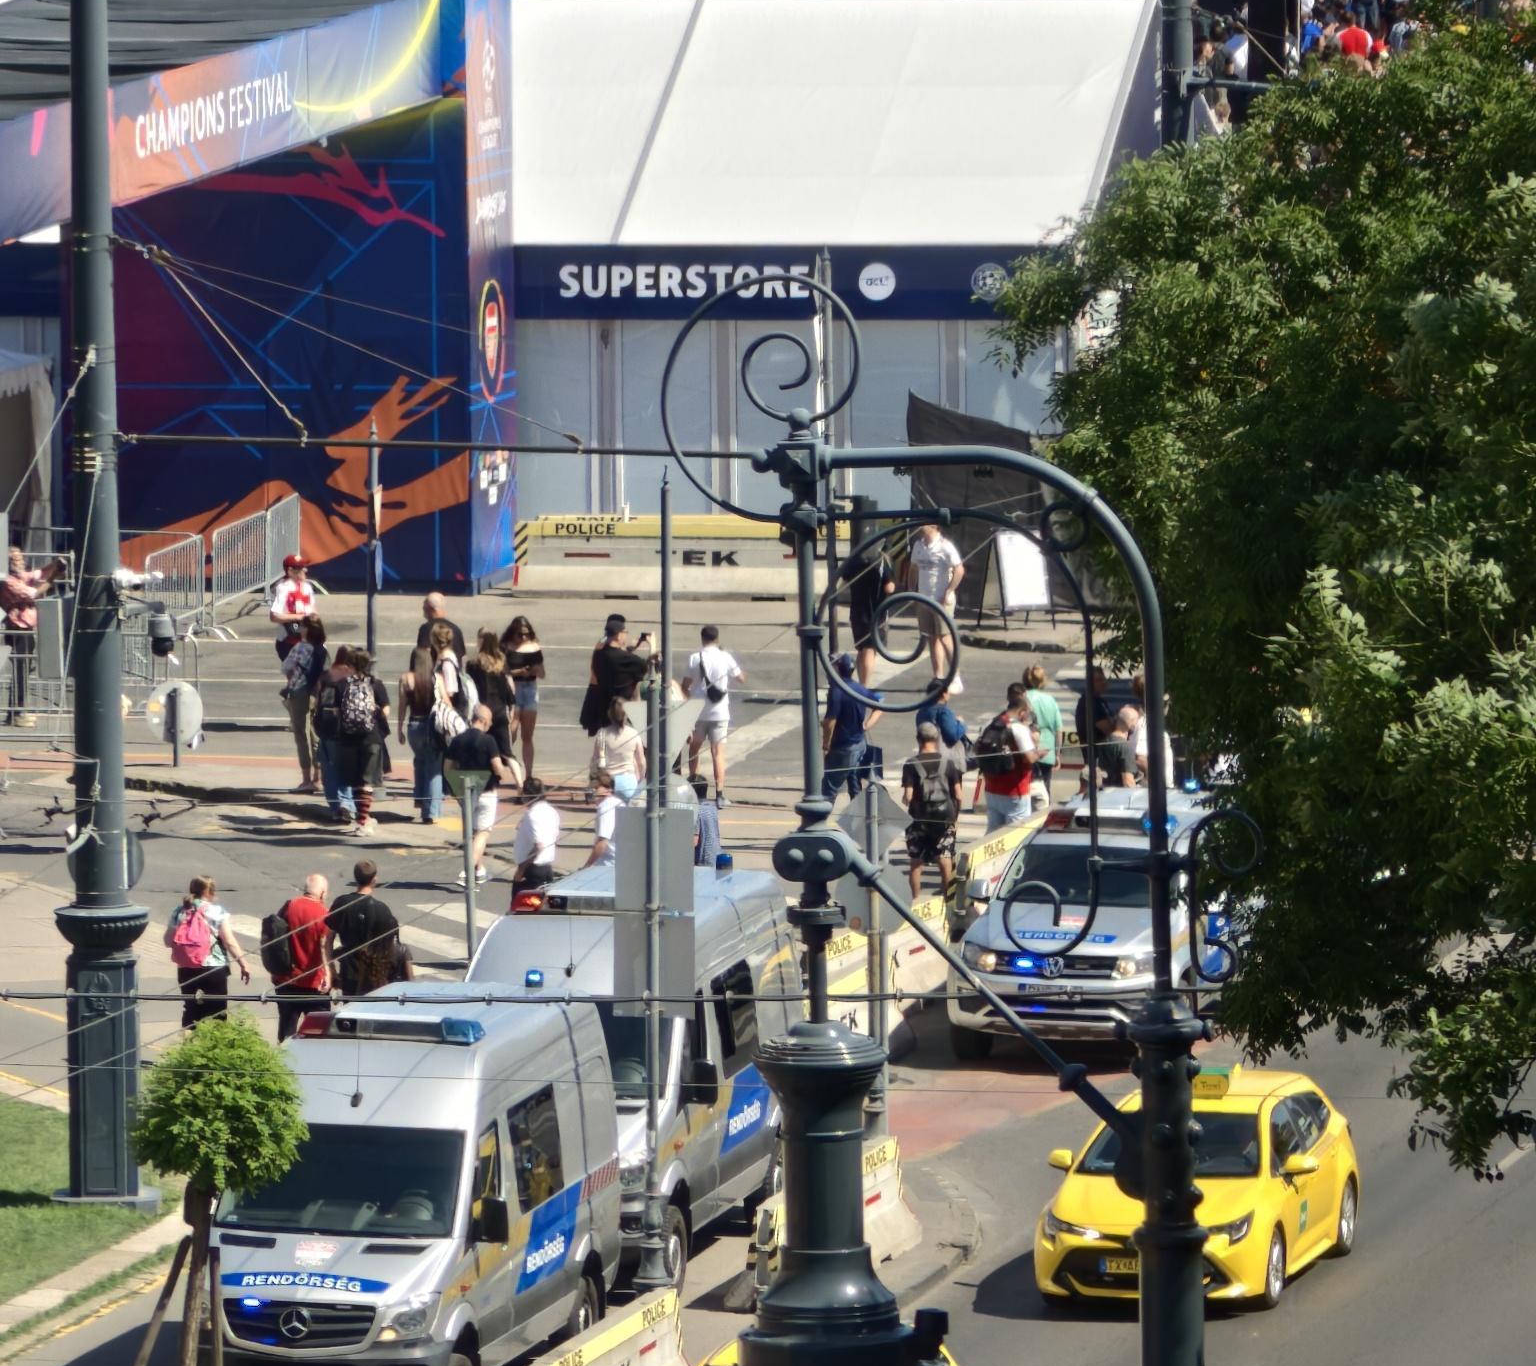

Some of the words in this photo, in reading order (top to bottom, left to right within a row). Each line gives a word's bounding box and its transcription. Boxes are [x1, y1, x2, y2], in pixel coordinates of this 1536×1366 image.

[135, 90, 225, 159] CHAMPIONS
[229, 71, 292, 129] FESTIVAL
[558, 264, 812, 300] SUPERSTORE
[554, 523, 616, 536] POLICE
[865, 1145, 887, 1171] POLICE
[242, 1273, 362, 1292] RENDŐRSÉG
[642, 1298, 666, 1329] POLICE
